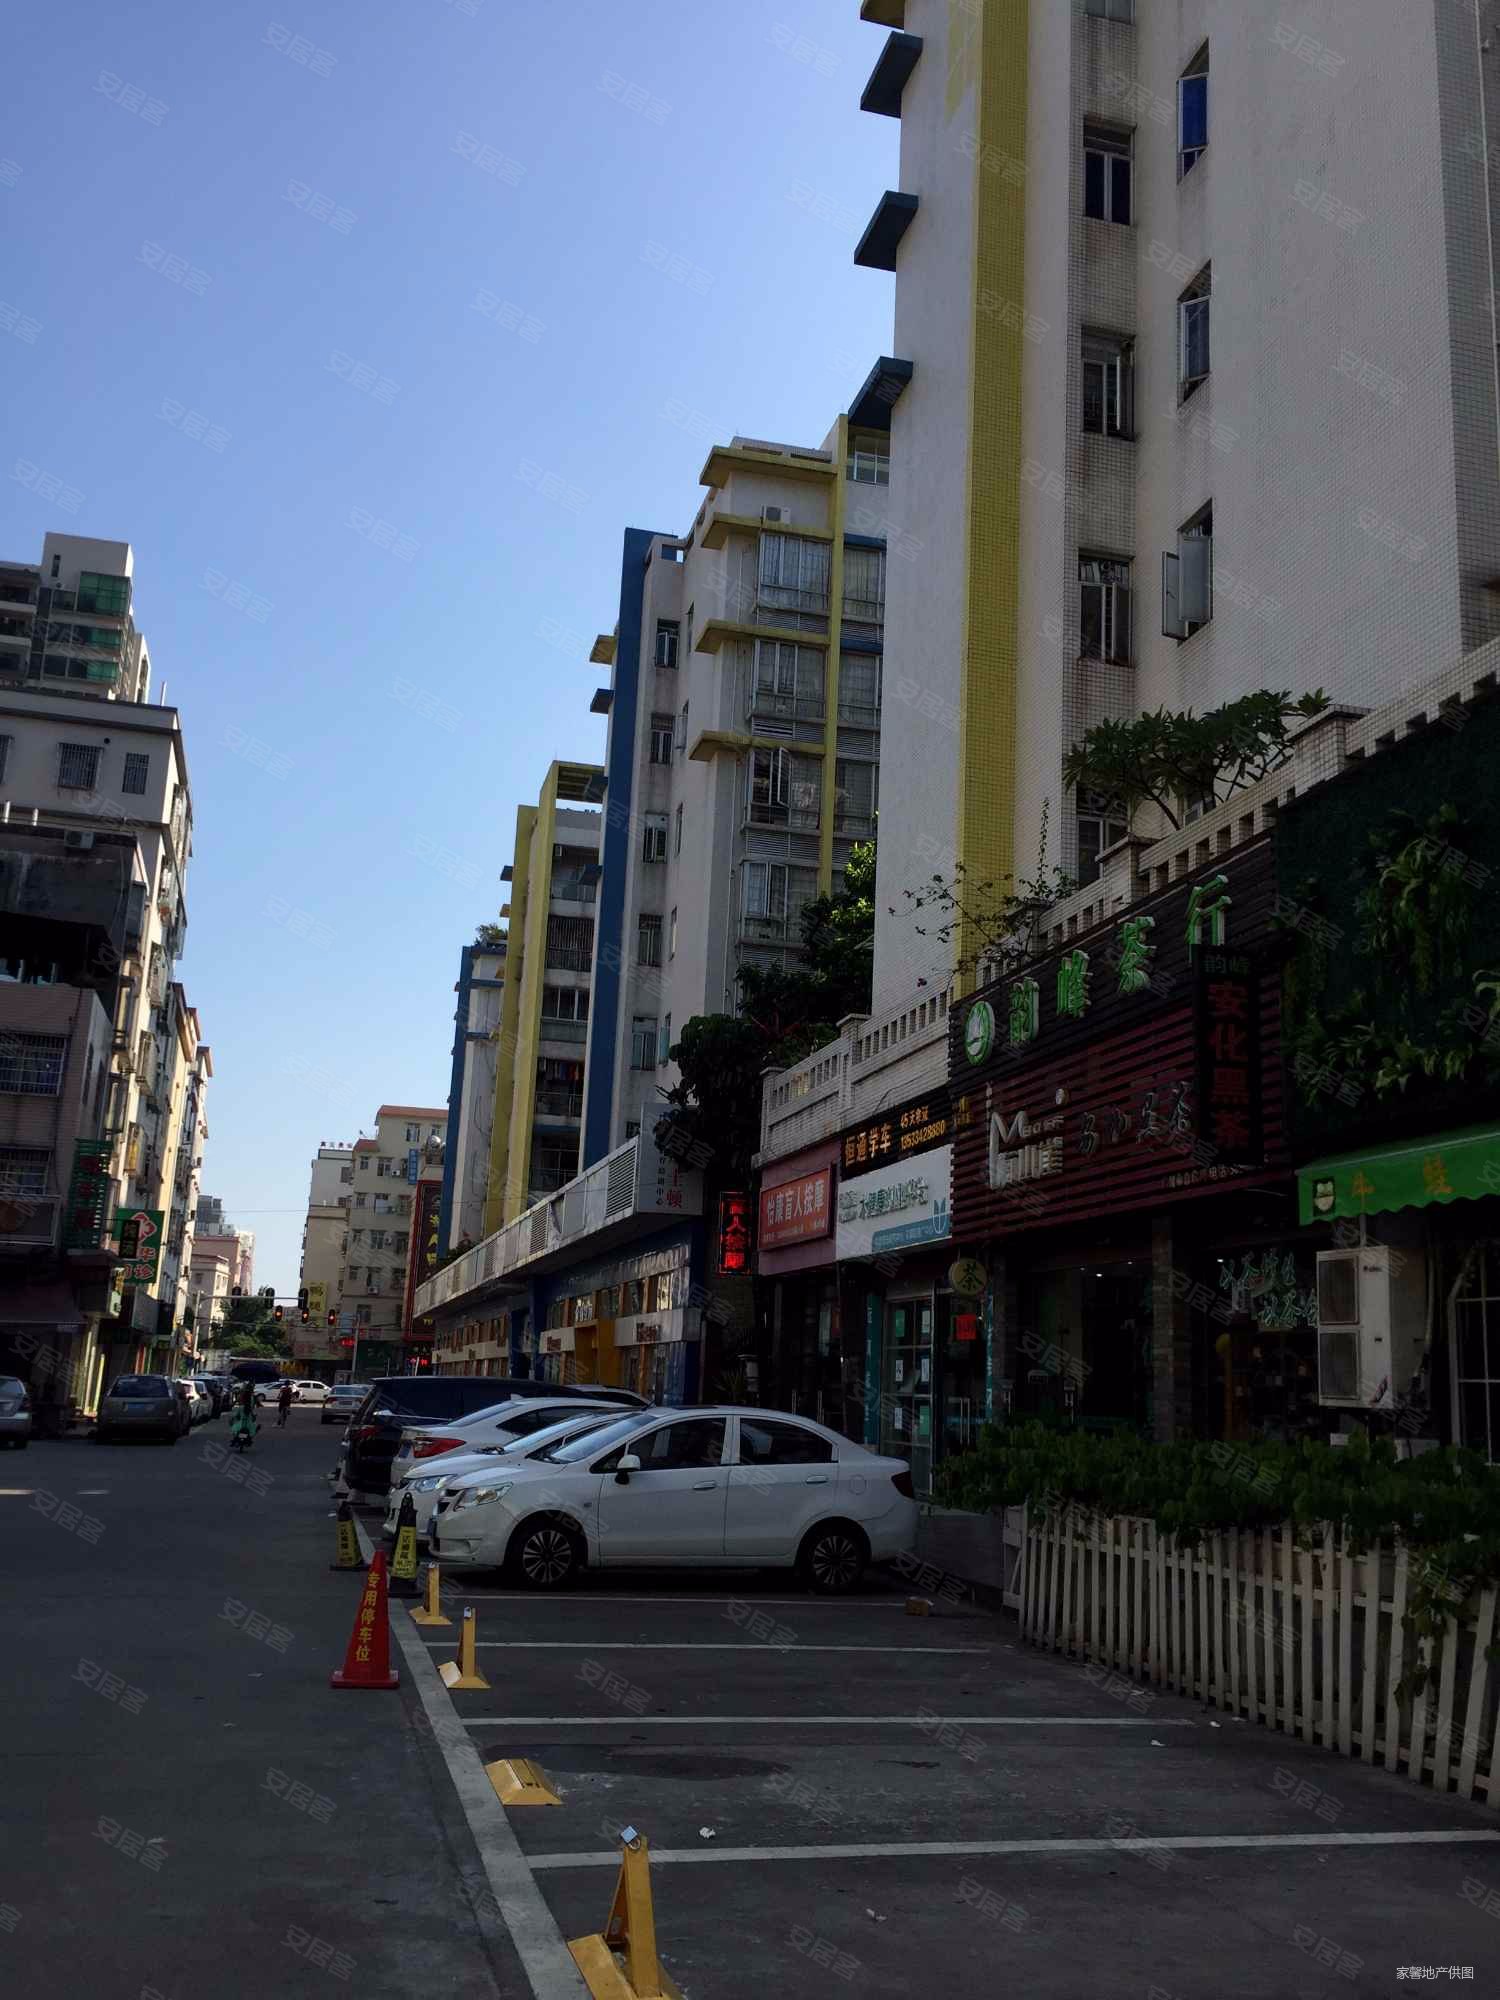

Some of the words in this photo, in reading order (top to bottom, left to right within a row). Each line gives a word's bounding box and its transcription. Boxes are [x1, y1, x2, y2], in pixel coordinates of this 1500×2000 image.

[355, 1571, 381, 1662] 专用停车位
